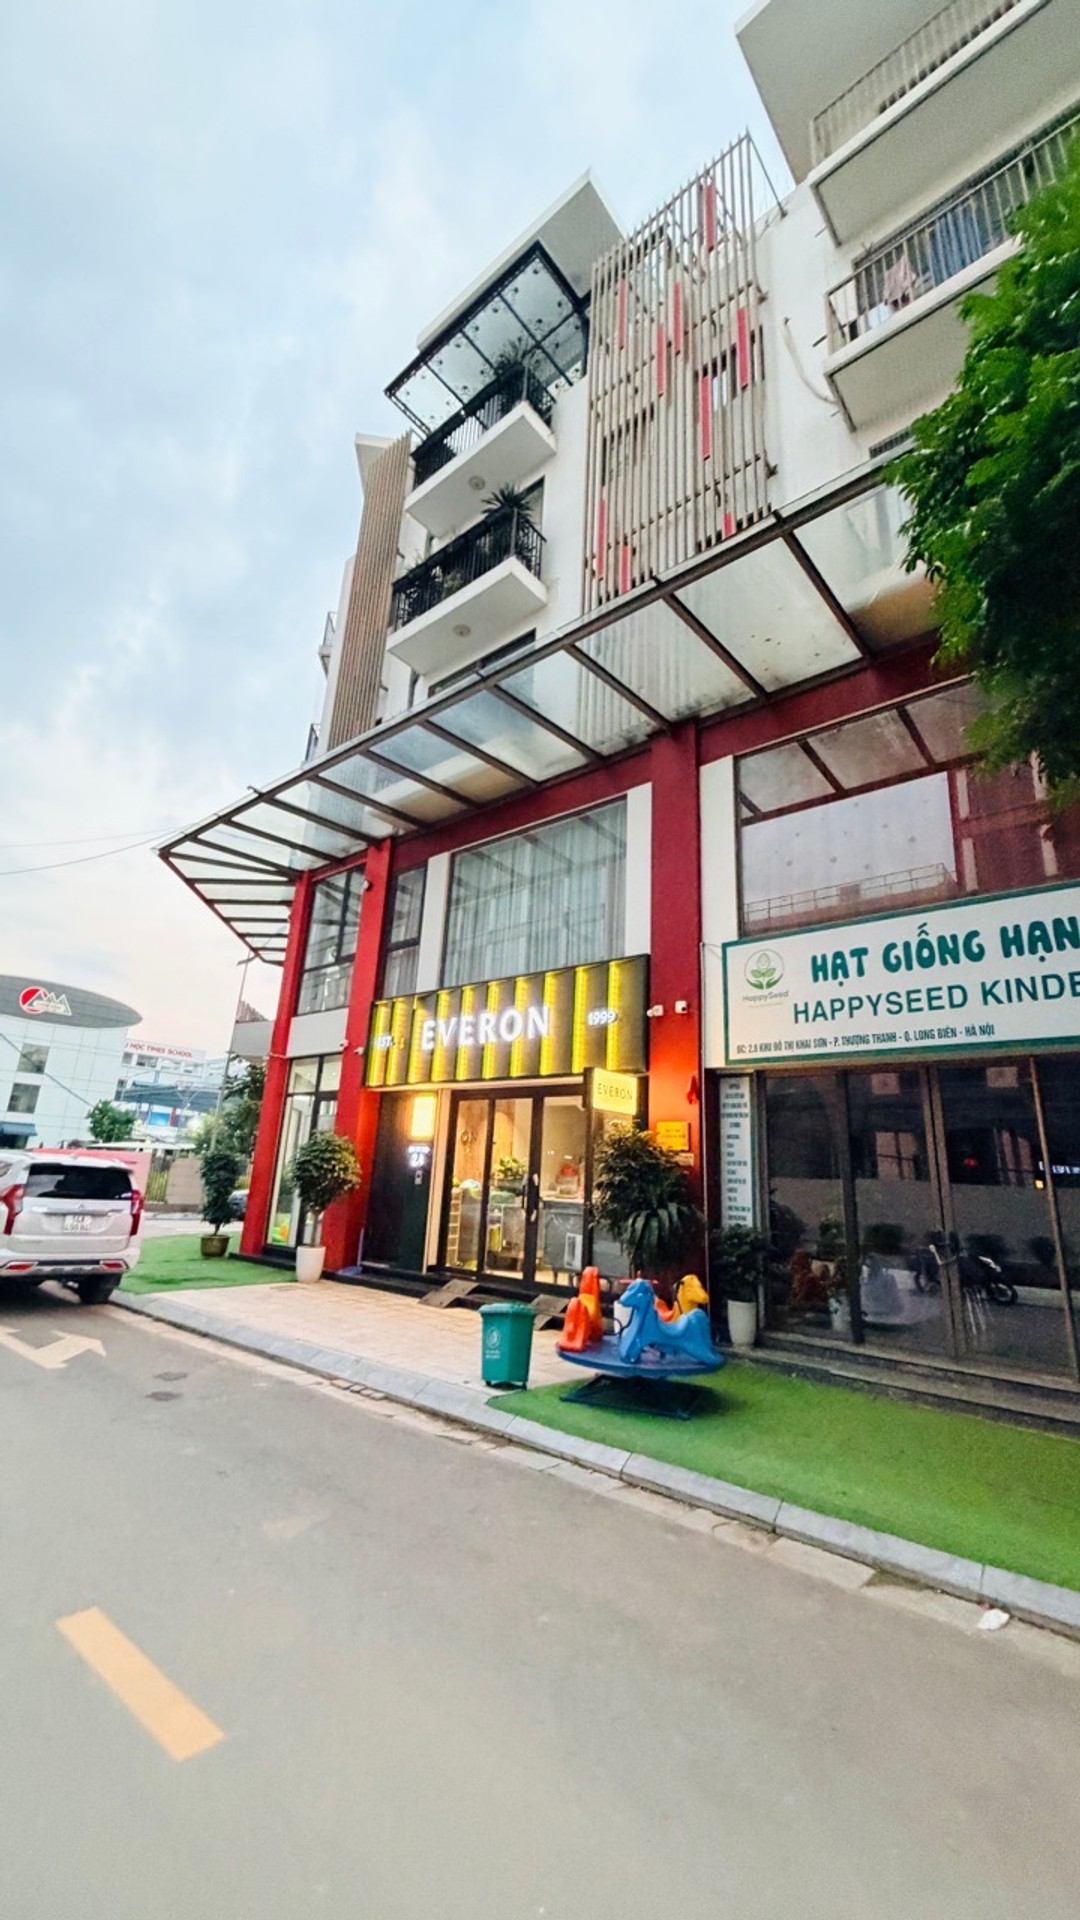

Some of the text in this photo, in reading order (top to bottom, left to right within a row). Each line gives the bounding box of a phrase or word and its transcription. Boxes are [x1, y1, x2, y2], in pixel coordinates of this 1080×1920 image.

[811, 916, 1080, 987] HẠT GIỐNG HẠN
[793, 971, 1080, 1025] HAPPYSEED KINDE
[421, 1005, 549, 1051] EVERON
[796, 1038, 811, 1049] KHAI
[833, 1037, 841, 1047] P.
[872, 1032, 897, 1044] THANH
[914, 1028, 935, 1040] LONG
[937, 1025, 957, 1039] BIÊN
[964, 1022, 977, 1037] HÀ
[979, 1021, 995, 1037] NỘI
[597, 1082, 633, 1101] EVERON
